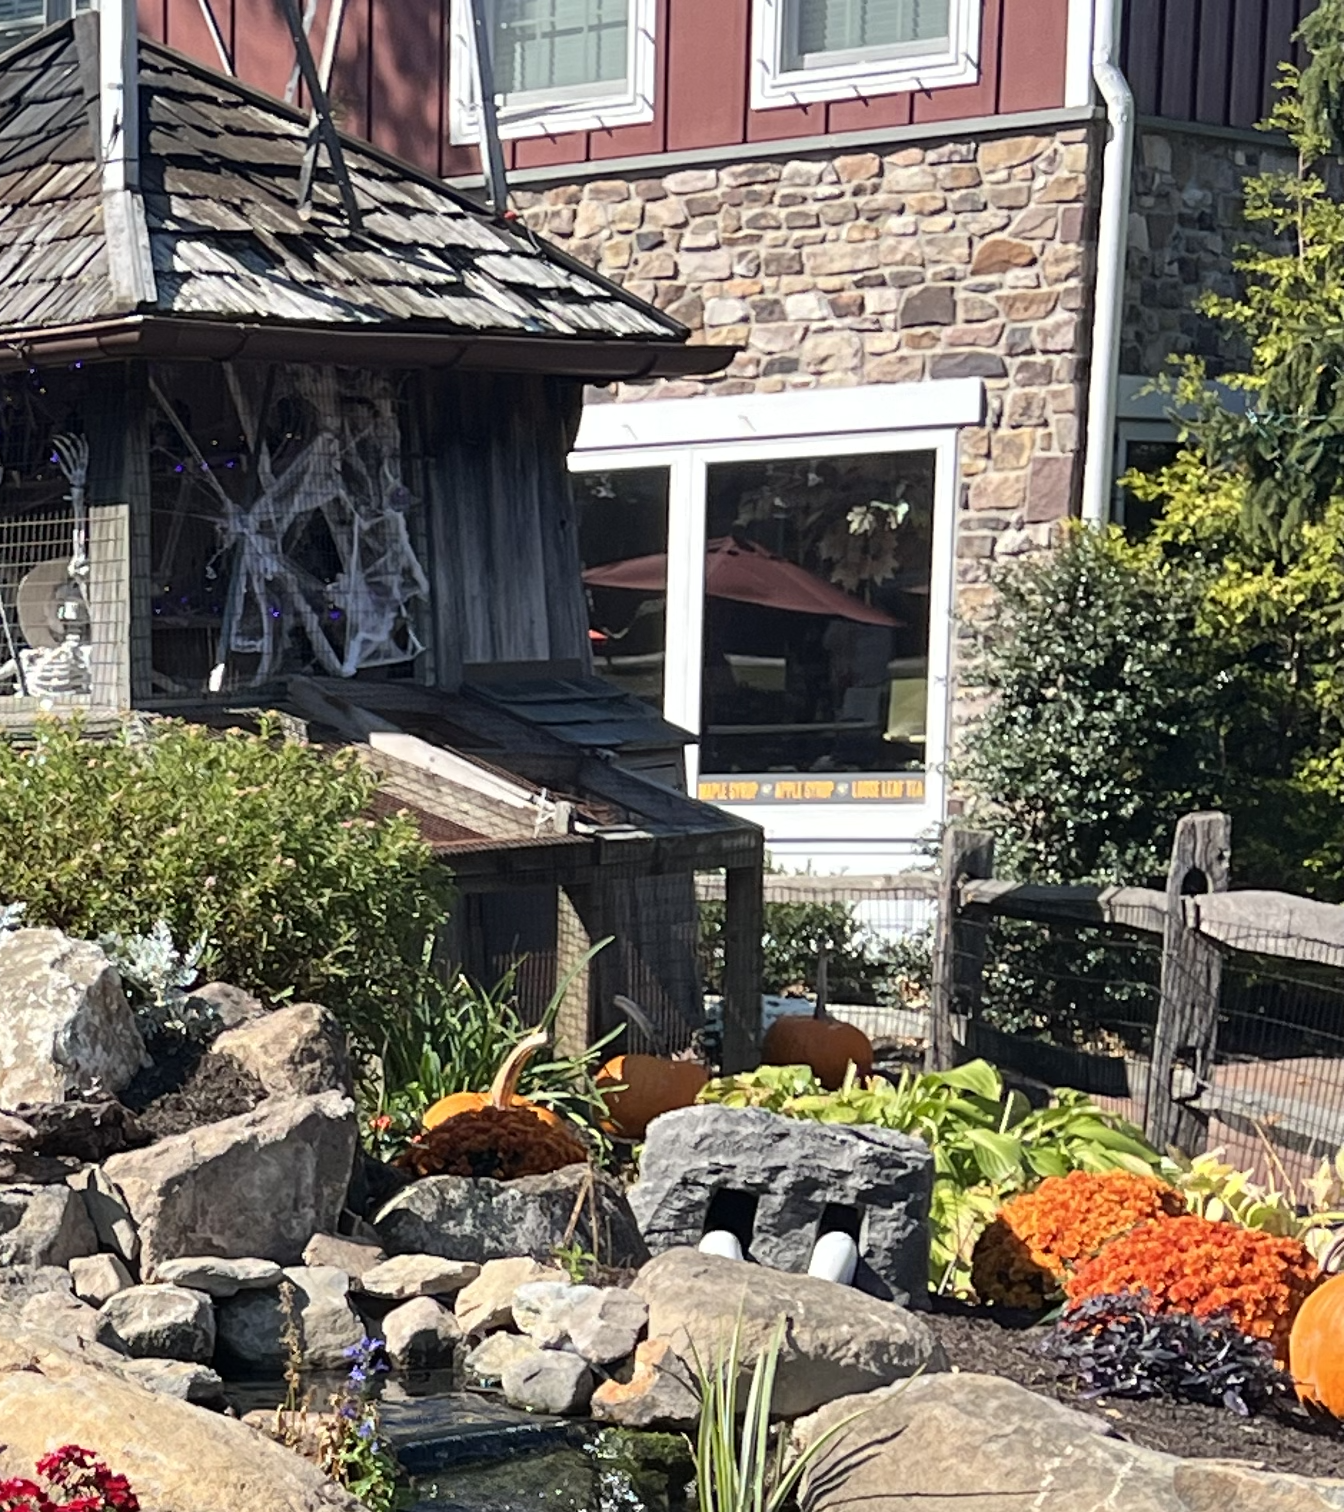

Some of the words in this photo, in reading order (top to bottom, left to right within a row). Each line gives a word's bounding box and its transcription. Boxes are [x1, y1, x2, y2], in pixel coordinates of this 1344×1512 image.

[698, 782, 728, 800] MAPLE
[775, 781, 802, 799] APPLE
[881, 780, 904, 799] LEAF
[906, 780, 923, 798] TEA
